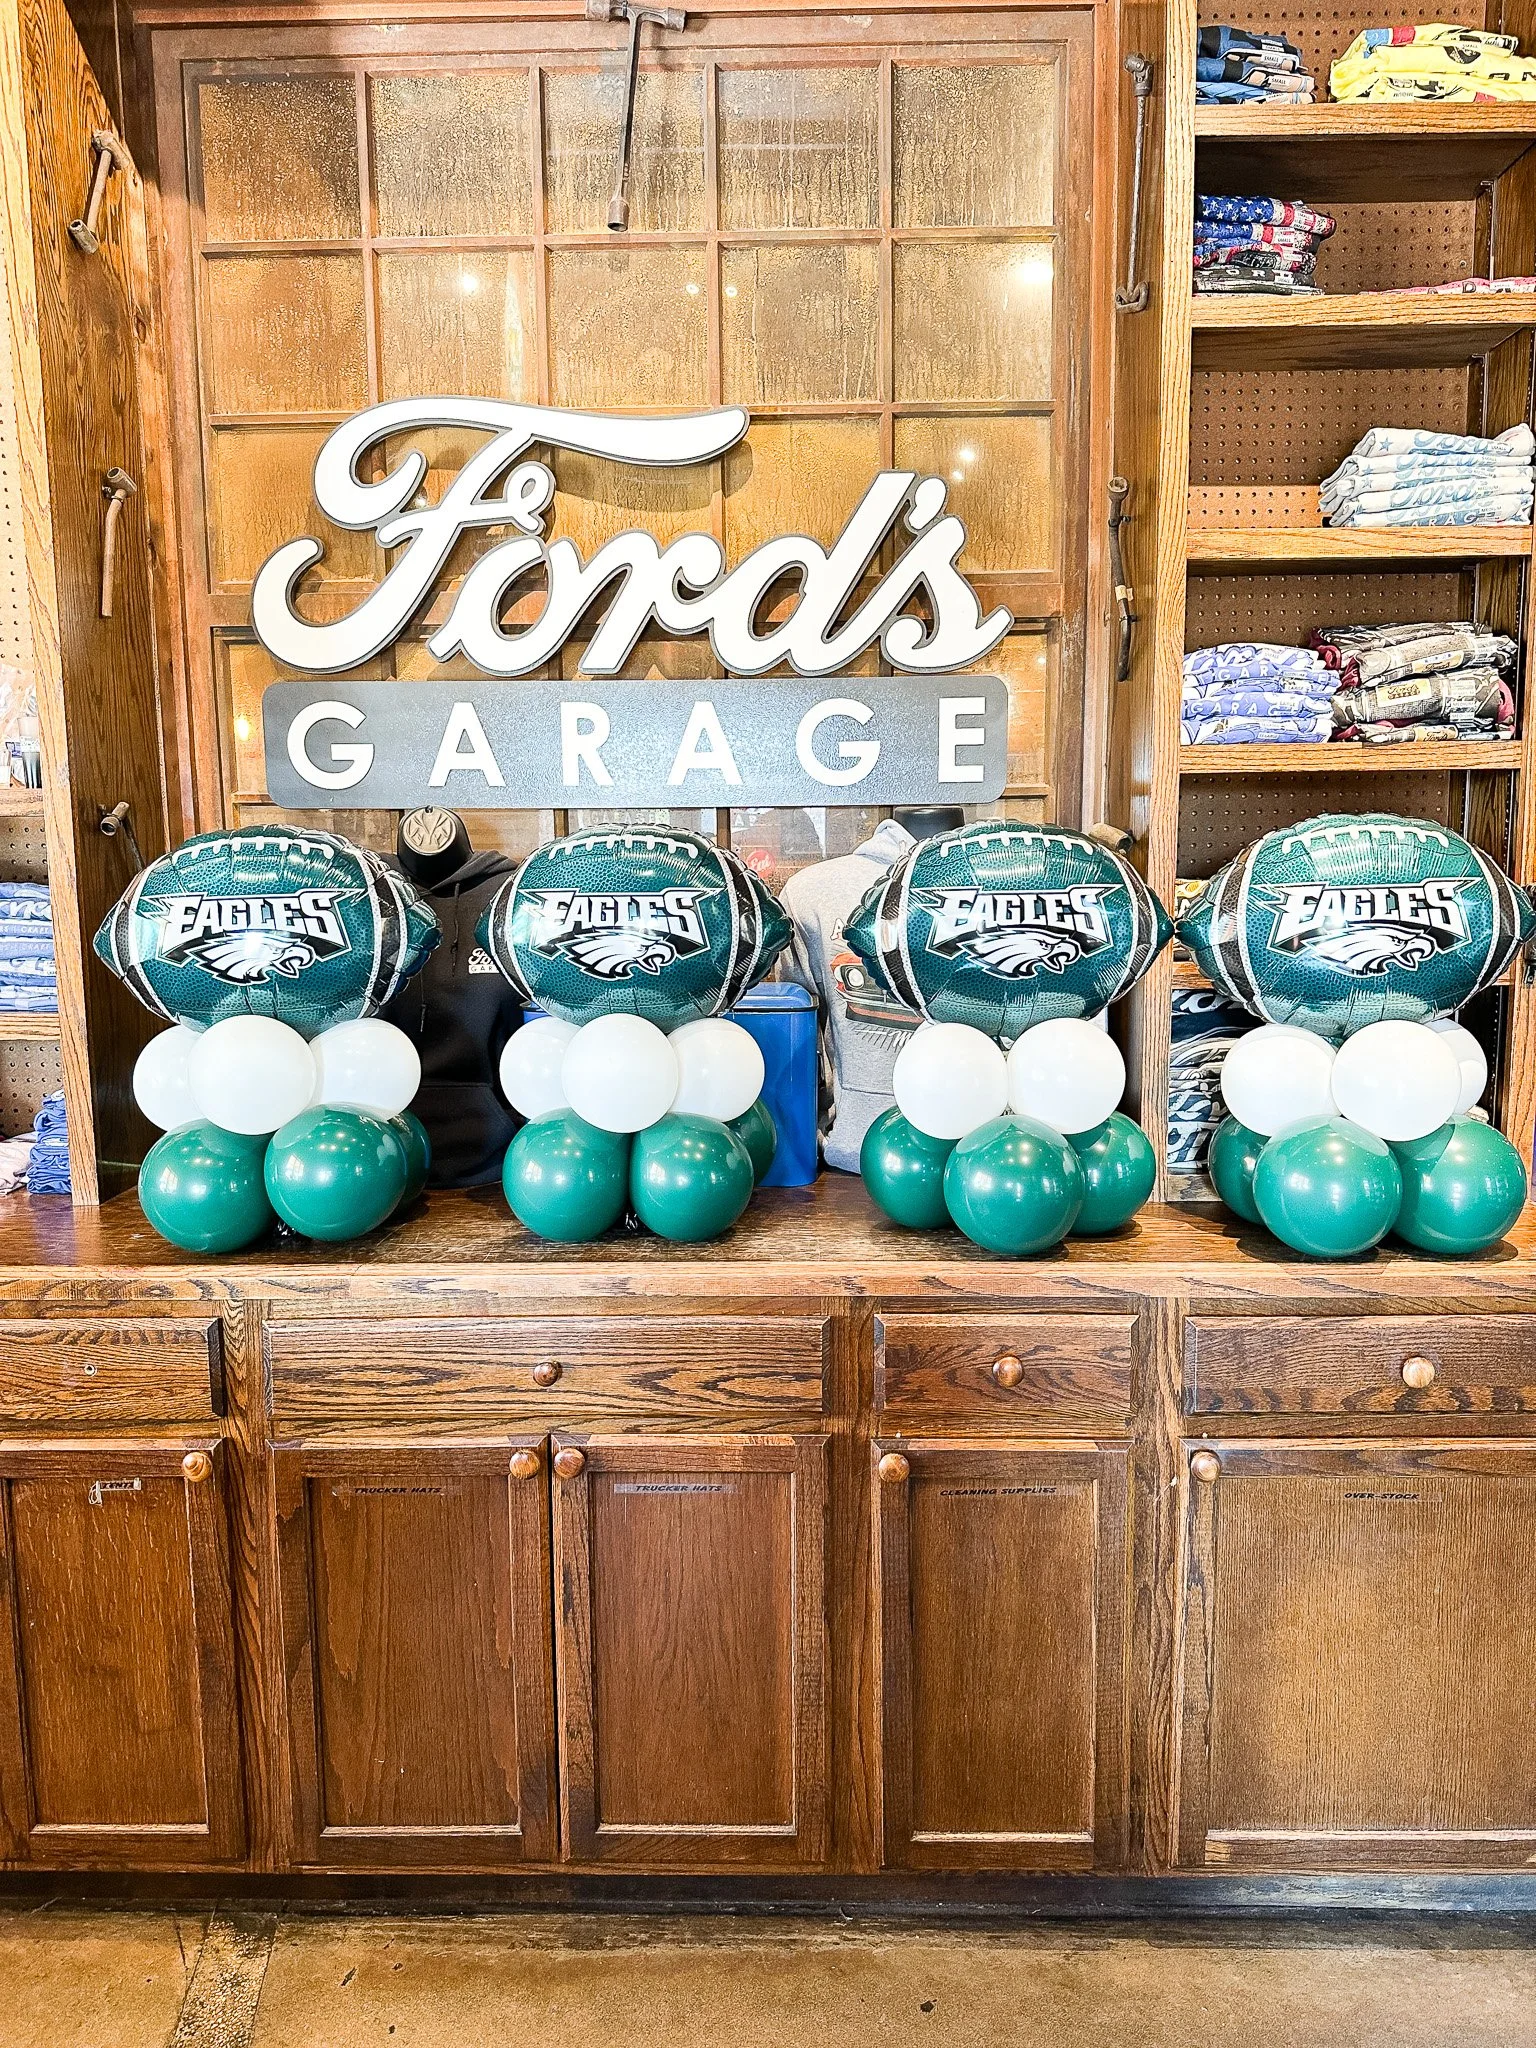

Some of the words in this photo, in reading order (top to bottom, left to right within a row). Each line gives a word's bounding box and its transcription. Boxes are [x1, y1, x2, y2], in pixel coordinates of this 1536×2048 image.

[251, 396, 1015, 677] Ford's
[287, 697, 986, 790] GARAGE
[158, 889, 354, 948] EAGLES
[530, 888, 708, 946] EAGLES
[928, 886, 1114, 948] EAGLES
[1270, 879, 1472, 948] EAGLES
[939, 1488, 998, 1497] CLEANING
[1000, 1487, 1058, 1495] SUPPLIES
[1343, 1492, 1420, 1500] OVER-STOCK
